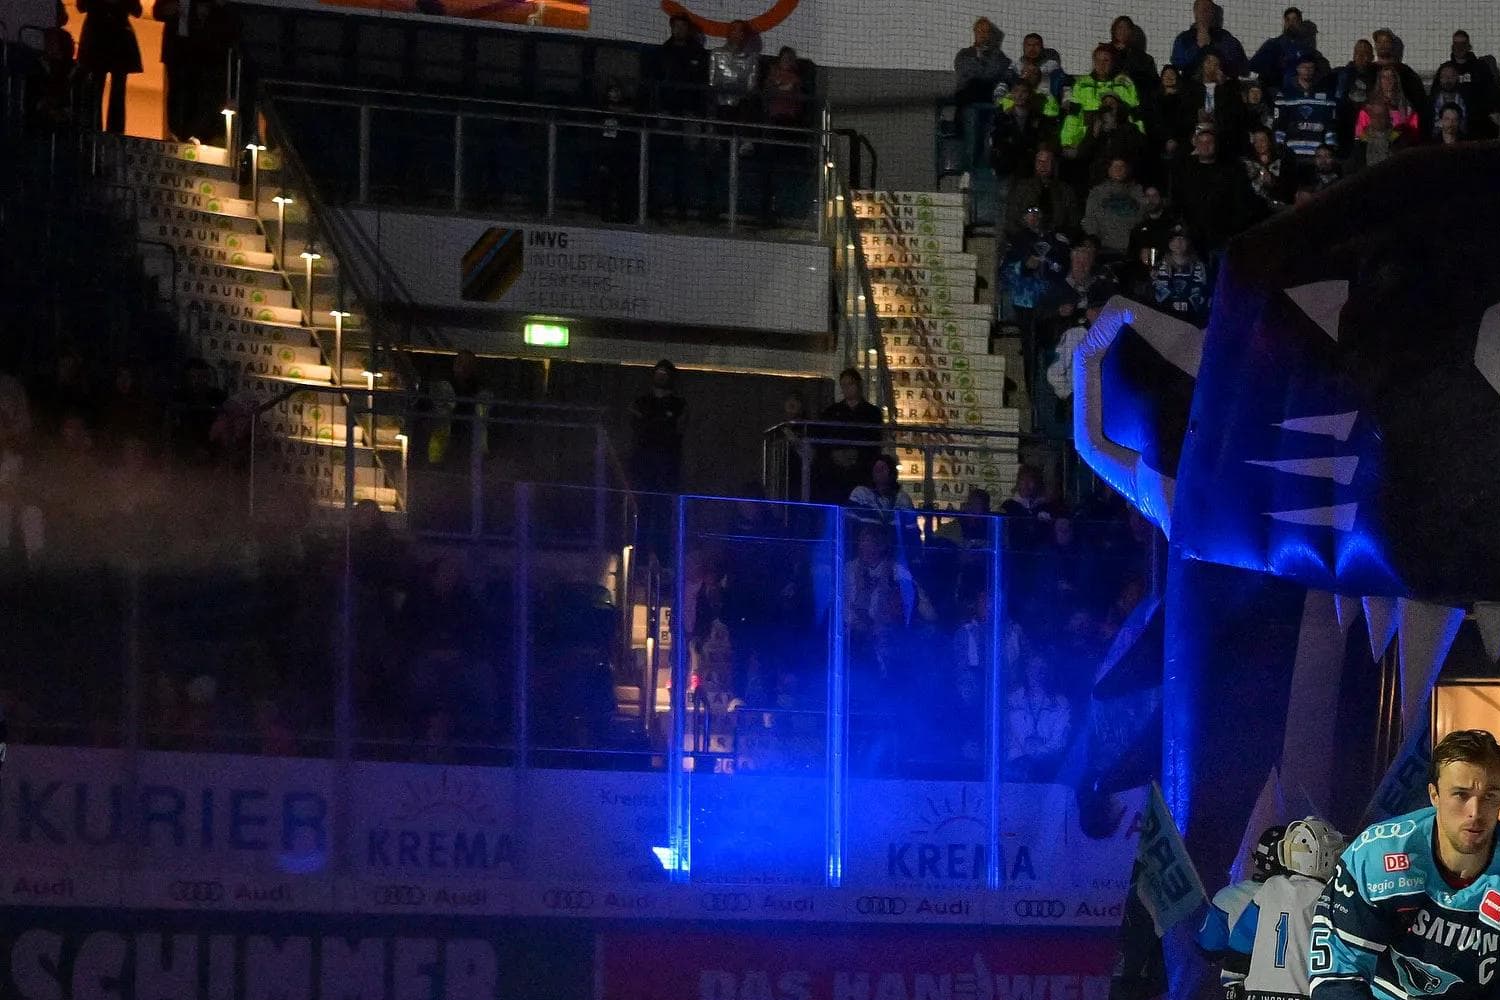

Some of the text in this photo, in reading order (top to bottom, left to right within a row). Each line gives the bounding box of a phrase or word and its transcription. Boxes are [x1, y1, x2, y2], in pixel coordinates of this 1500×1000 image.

[159, 224, 219, 243] BRAUN
[529, 230, 569, 249] INVG
[861, 235, 919, 248] BRAUN
[864, 252, 921, 265] BRAUN
[183, 280, 246, 299] BRAUN
[210, 337, 273, 357] BRAUN
[886, 355, 948, 367] BRAUN
[893, 390, 956, 402] BRAUN
[895, 408, 960, 419] BRAUN
[262, 420, 314, 437] RAUN
[911, 463, 975, 476] BAUN
[913, 482, 976, 495] BAU
[15, 778, 331, 855] KURIER
[366, 828, 522, 870] KREMA
[886, 842, 1038, 882] KREMA
[1386, 855, 1407, 869] DB
[13, 877, 75, 896] Audi
[234, 882, 293, 900] Audi
[1366, 880, 1395, 893] Regio
[1398, 876, 1425, 892] Baye
[434, 886, 488, 905] Audi
[763, 892, 815, 910] Audi
[915, 895, 970, 915] Audi
[1075, 898, 1122, 917] Aud
[1273, 912, 1290, 969] 1
[1309, 926, 1332, 975] 5
[1478, 957, 1498, 985] C
